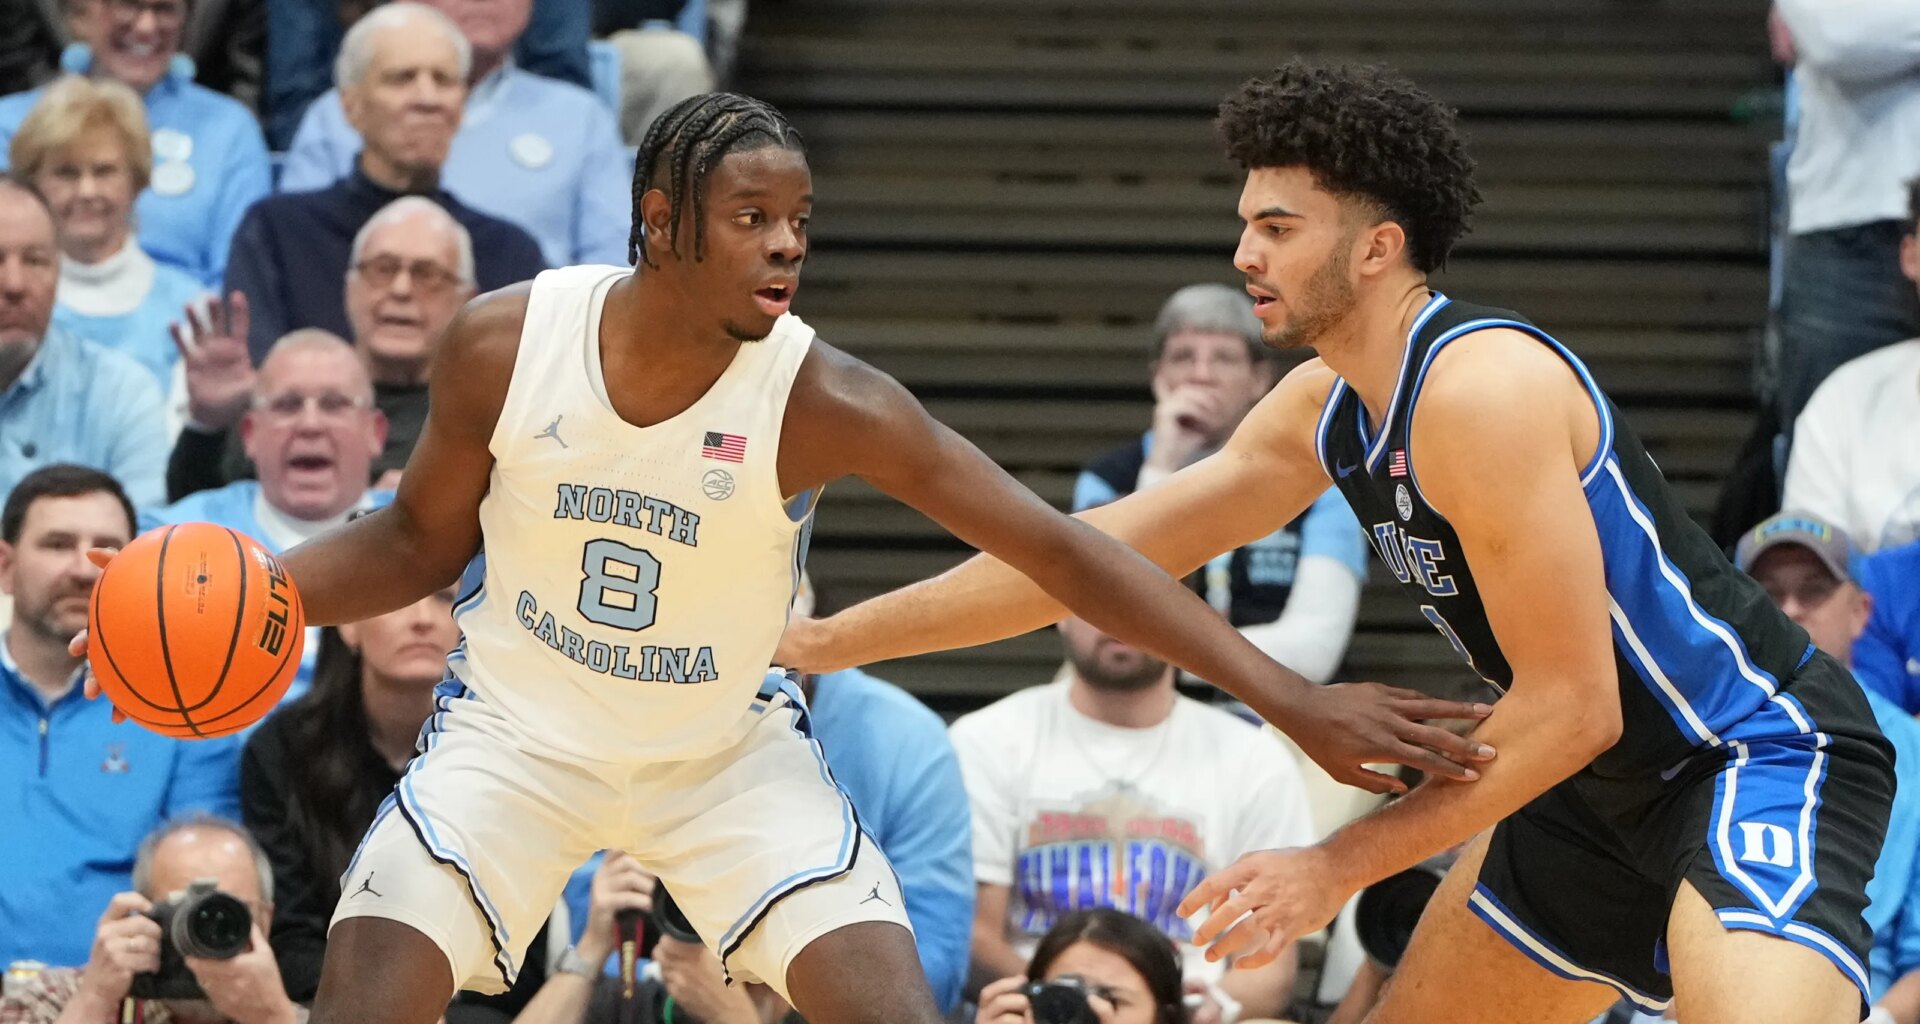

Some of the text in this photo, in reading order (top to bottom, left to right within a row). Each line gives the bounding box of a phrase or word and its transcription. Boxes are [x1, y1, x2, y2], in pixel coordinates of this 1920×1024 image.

[554, 484, 700, 547] NORTH
[258, 552, 289, 656] ELITE
[577, 538, 662, 632] 8
[515, 590, 719, 684] CAROLINA
[1738, 821, 1794, 868] D
